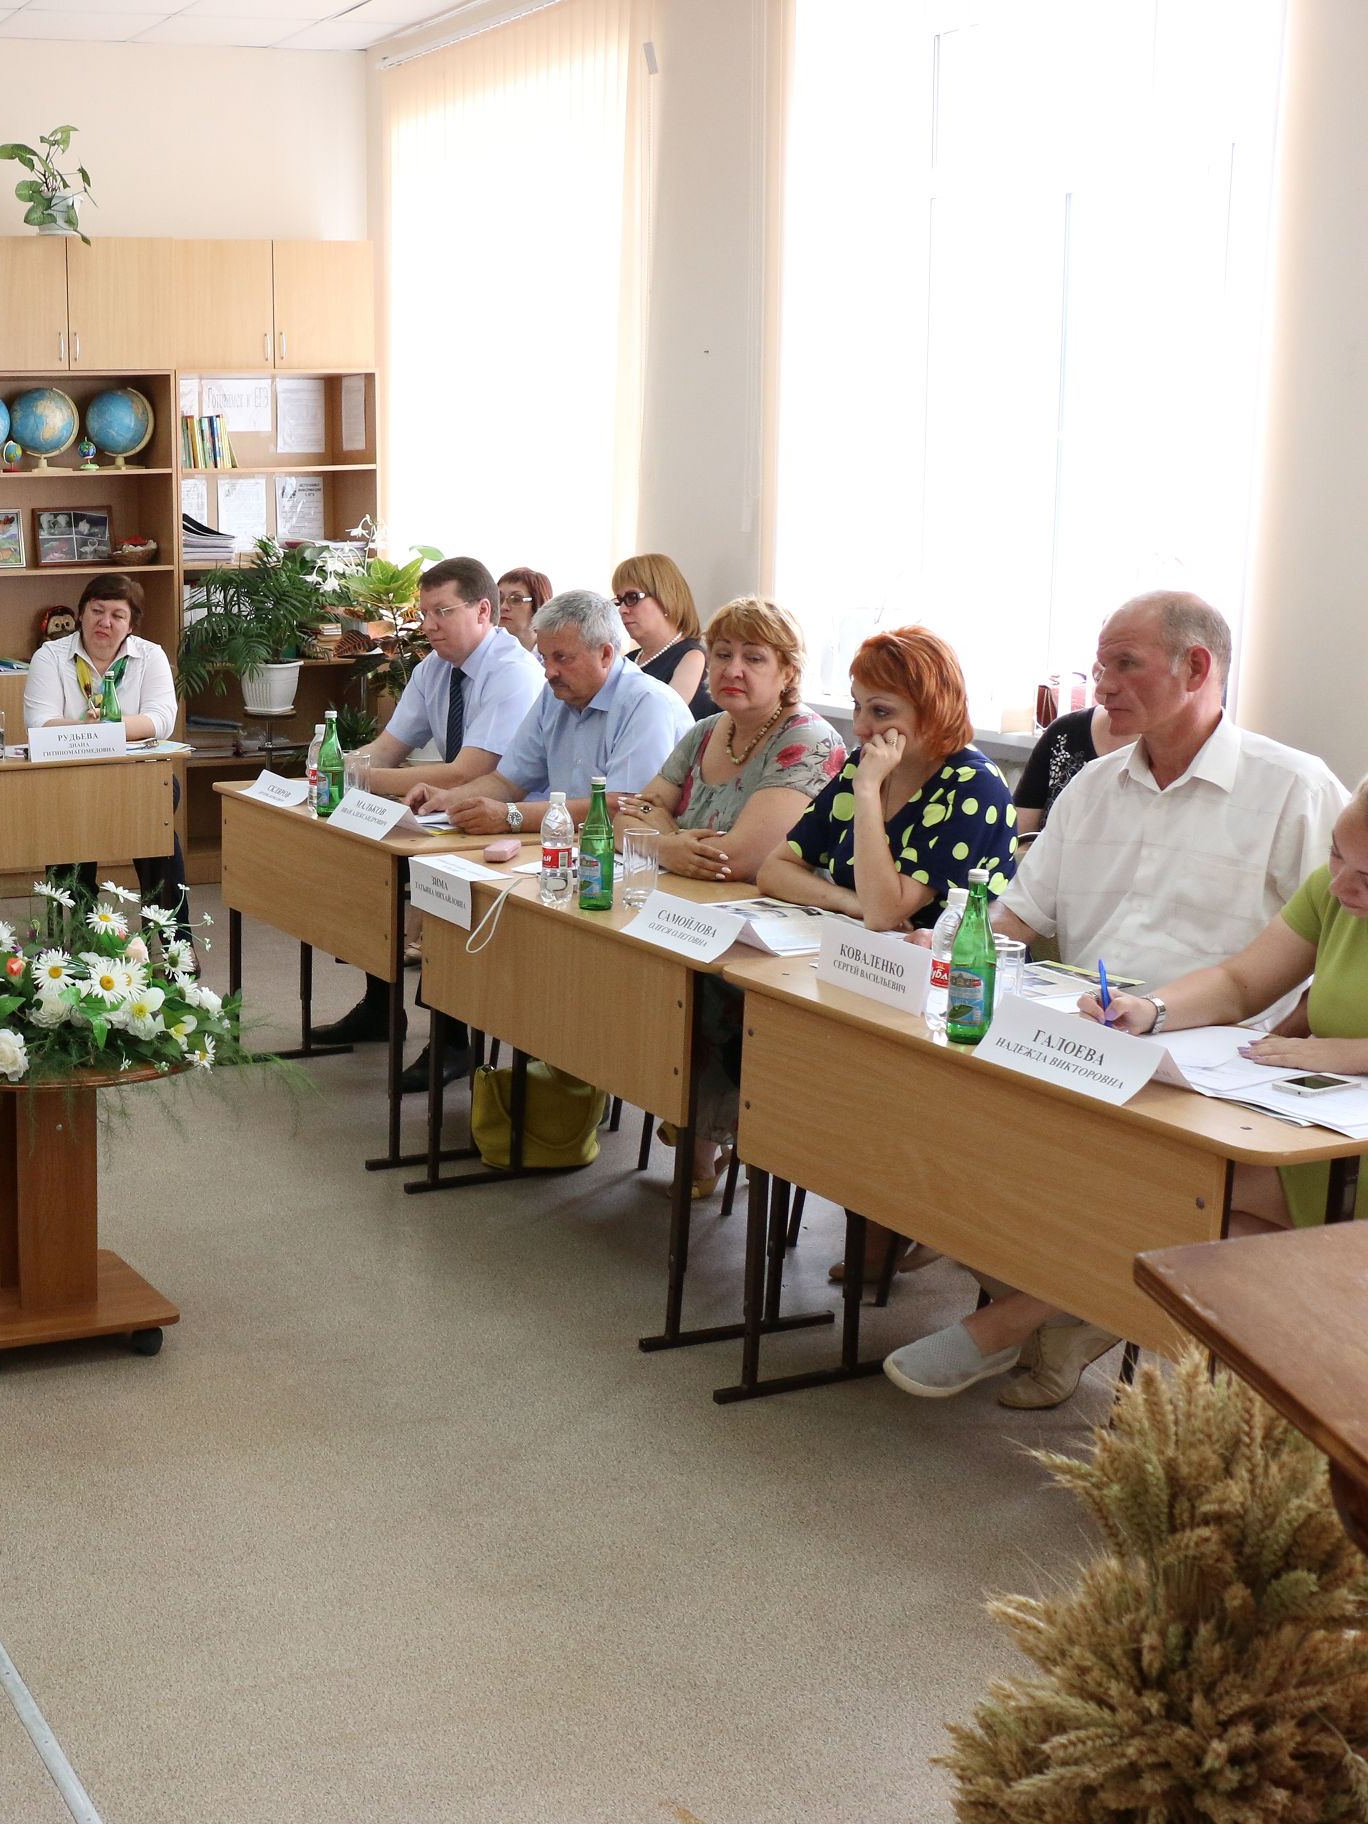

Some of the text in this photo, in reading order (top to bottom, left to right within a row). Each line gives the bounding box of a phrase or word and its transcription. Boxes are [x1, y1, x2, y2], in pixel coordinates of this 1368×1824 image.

[57, 732, 99, 741] РУДЬЕВА
[357, 800, 387, 816] МАЛЬКОВ
[432, 876, 448, 891] ЗИМА
[657, 909, 718, 938] САМОЙЛОВА
[671, 929, 708, 948] ОЛЕГОВНА
[840, 943, 904, 978] КОВАЛЕНКО
[833, 959, 906, 994] СЕРГЕЙ ВАСИЛЬЕВИЧ
[1033, 1029, 1105, 1067] ГАЛОЕВА
[995, 1037, 1124, 1090] НАДЕЖДА ВИКТОРОВНА
